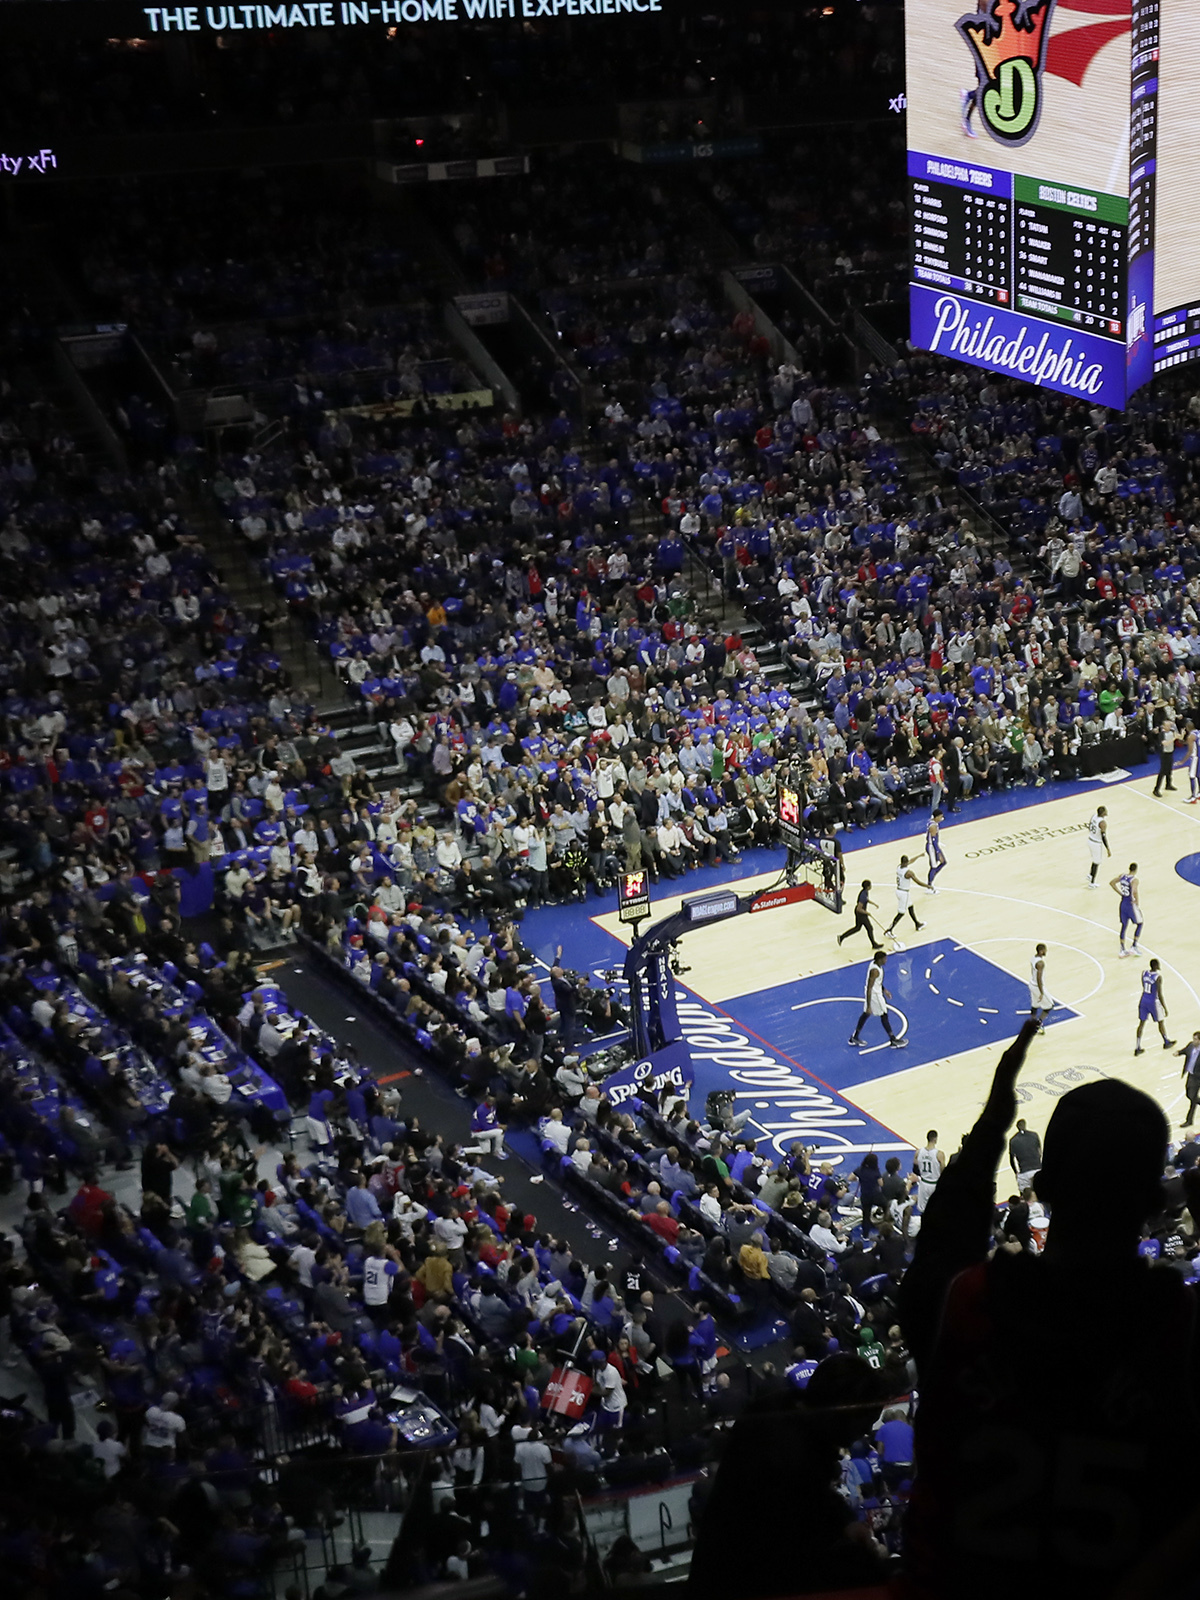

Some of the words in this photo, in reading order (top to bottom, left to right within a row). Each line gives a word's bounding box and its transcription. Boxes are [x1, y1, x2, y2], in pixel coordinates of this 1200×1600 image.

[144, 7, 200, 32] THE
[206, 3, 335, 30] ULTIMATE
[341, 0, 458, 25] IN-HOME
[464, 0, 515, 19] WIFI
[523, 0, 662, 17] EXPERIENCE
[0, 153, 23, 175] ty
[28, 149, 57, 173] xFi
[1039, 185, 1067, 204] BOSTON
[1067, 190, 1098, 212] CELTICS
[930, 296, 1104, 396] Philadelphia
[626, 882, 641, 897] 24
[608, 1066, 685, 1107] SPAING
[922, 1161, 932, 1173] 11
[808, 1174, 823, 1190] 27
[367, 1271, 378, 1285] 21
[627, 1277, 640, 1290] 21
[868, 1355, 880, 1369] 0
